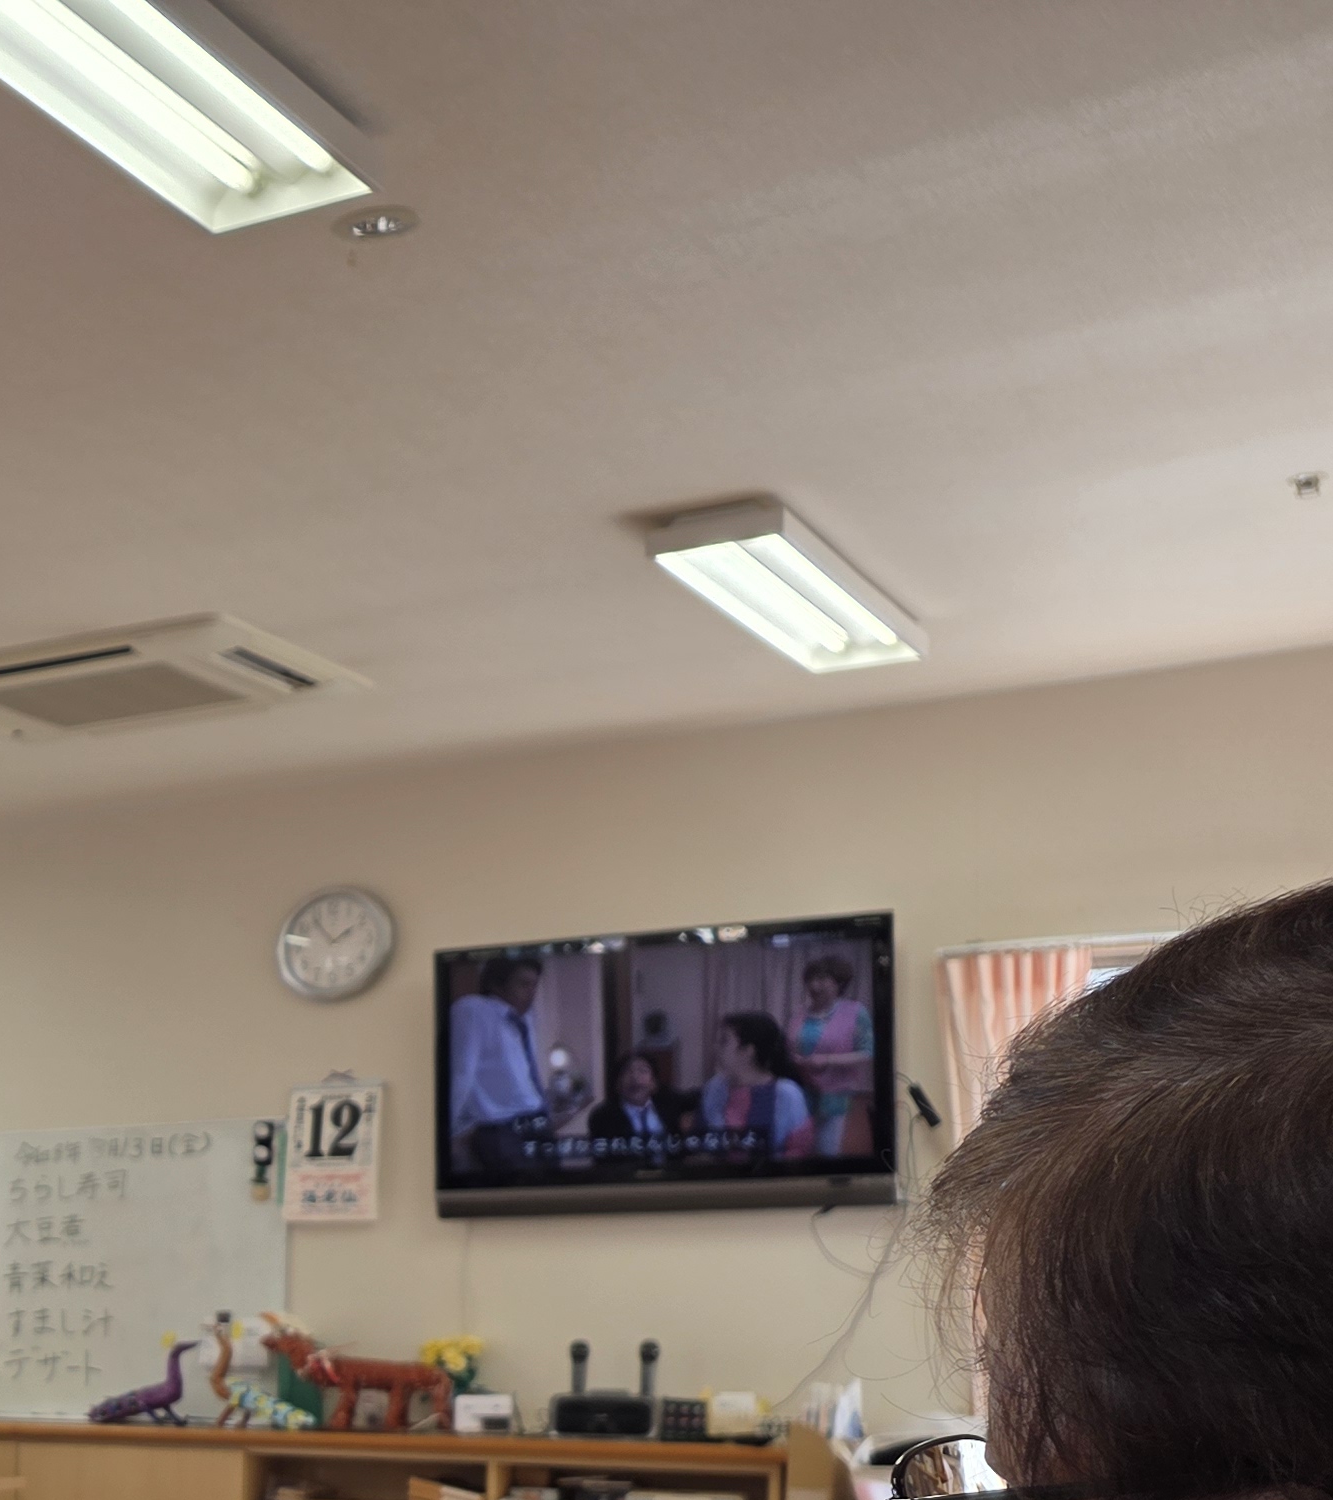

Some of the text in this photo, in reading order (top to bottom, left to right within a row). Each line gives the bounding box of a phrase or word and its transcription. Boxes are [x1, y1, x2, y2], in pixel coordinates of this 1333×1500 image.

[303, 1098, 363, 1157] 12
[9, 1168, 127, 1202] ちらし寿司
[8, 1307, 115, 1338] すまし汁
[3, 1345, 103, 1386] デザート
